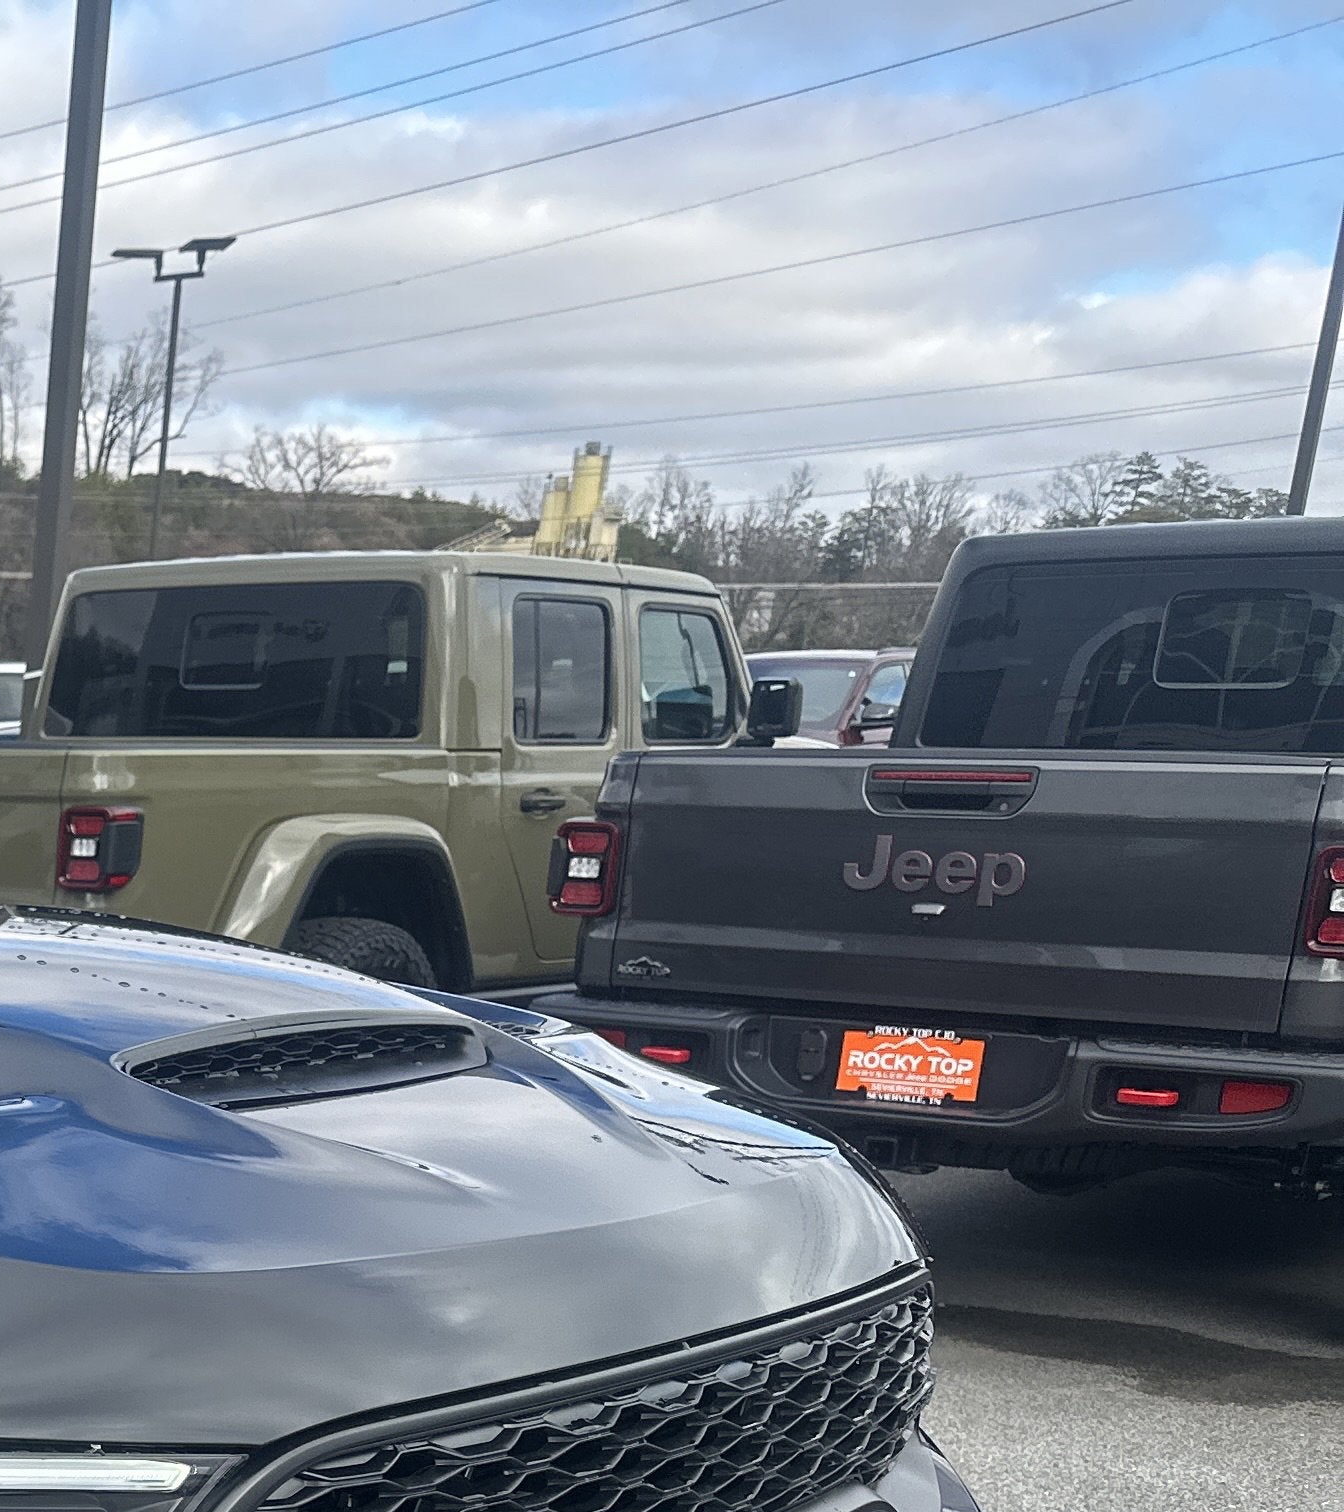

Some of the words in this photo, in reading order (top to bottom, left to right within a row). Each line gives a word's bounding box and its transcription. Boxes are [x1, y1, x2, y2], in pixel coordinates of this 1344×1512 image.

[843, 834, 1027, 907] Jeep
[874, 1025, 908, 1037] ROCKY
[912, 1027, 932, 1039] TOP
[847, 1050, 924, 1072] ROCKY
[927, 1055, 975, 1076] TOP
[845, 1068, 905, 1080] CHRYSLER
[928, 1074, 973, 1086] DODGE
